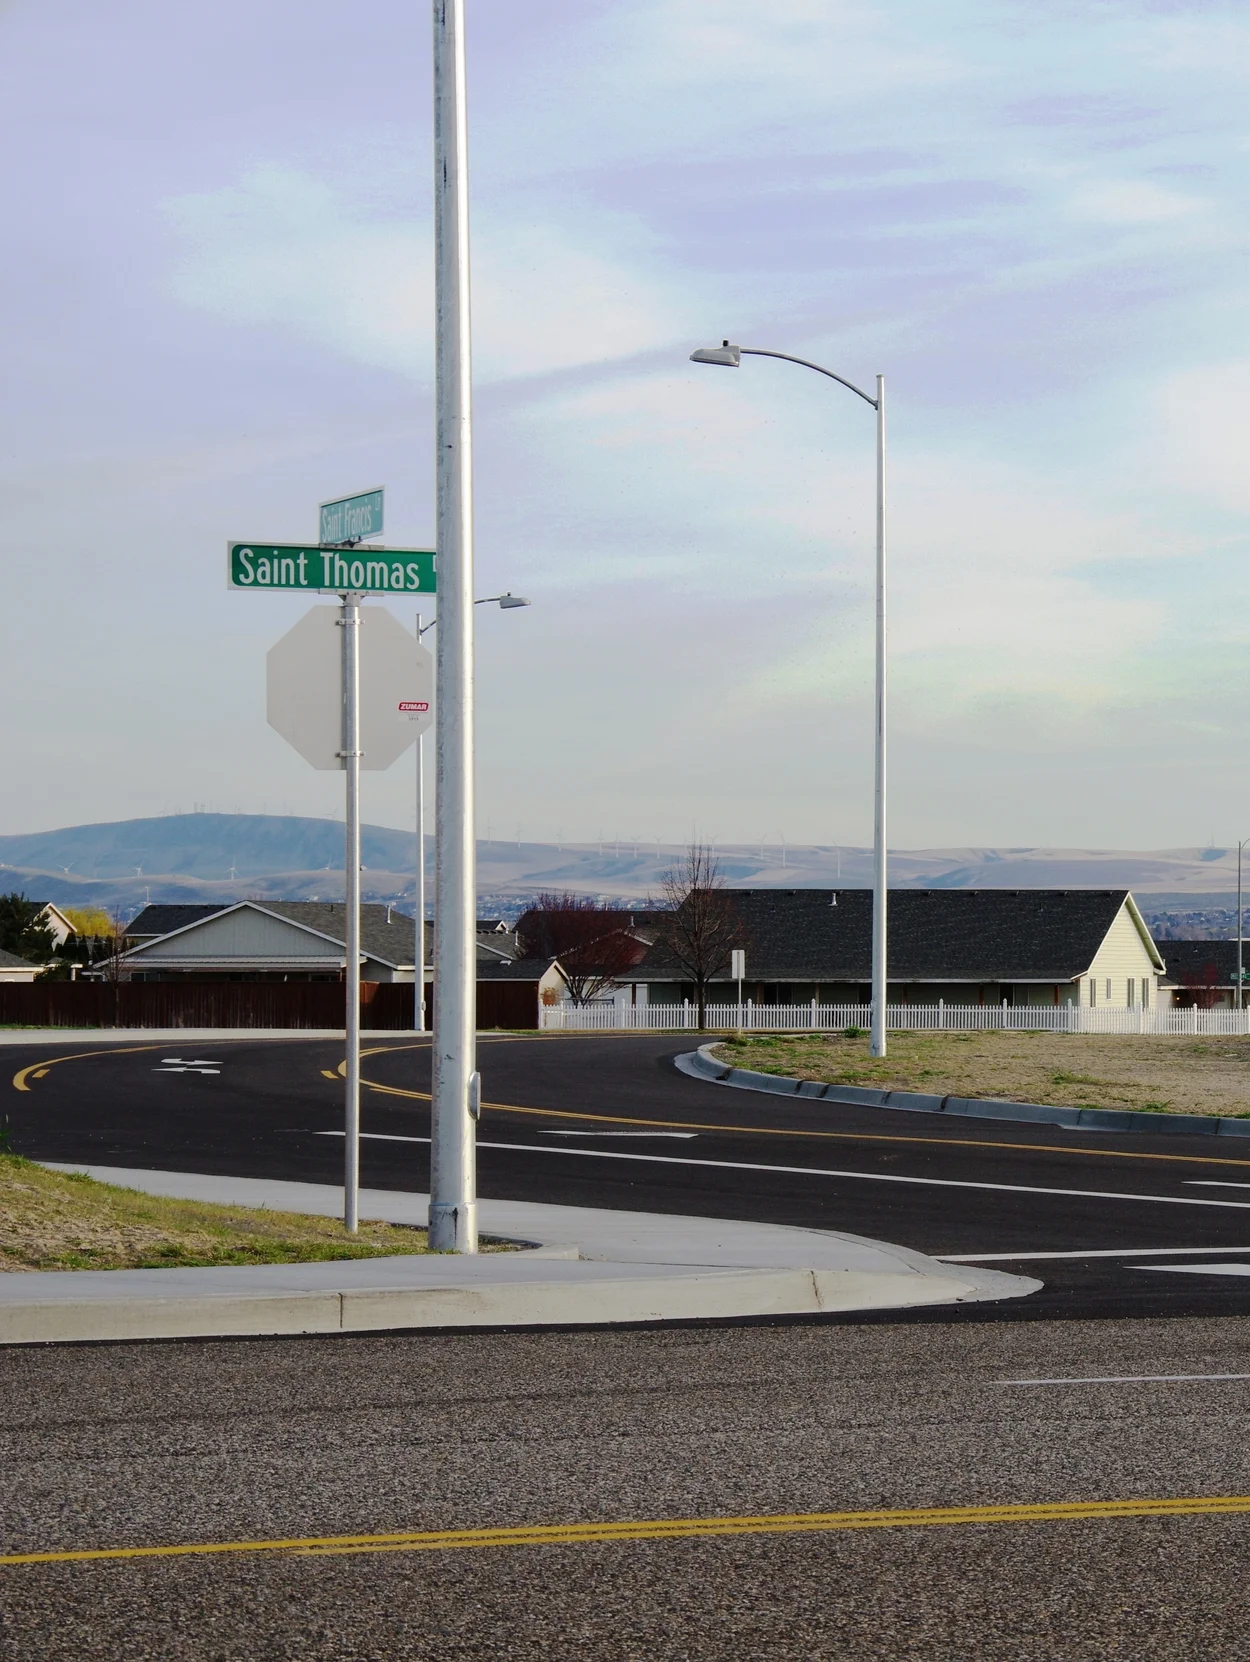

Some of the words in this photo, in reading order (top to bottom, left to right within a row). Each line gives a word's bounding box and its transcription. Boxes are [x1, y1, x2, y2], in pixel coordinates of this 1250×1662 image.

[322, 505, 342, 543] Saint
[344, 498, 372, 537] Francis
[239, 548, 308, 585] Saint
[320, 552, 420, 590] Thomas
